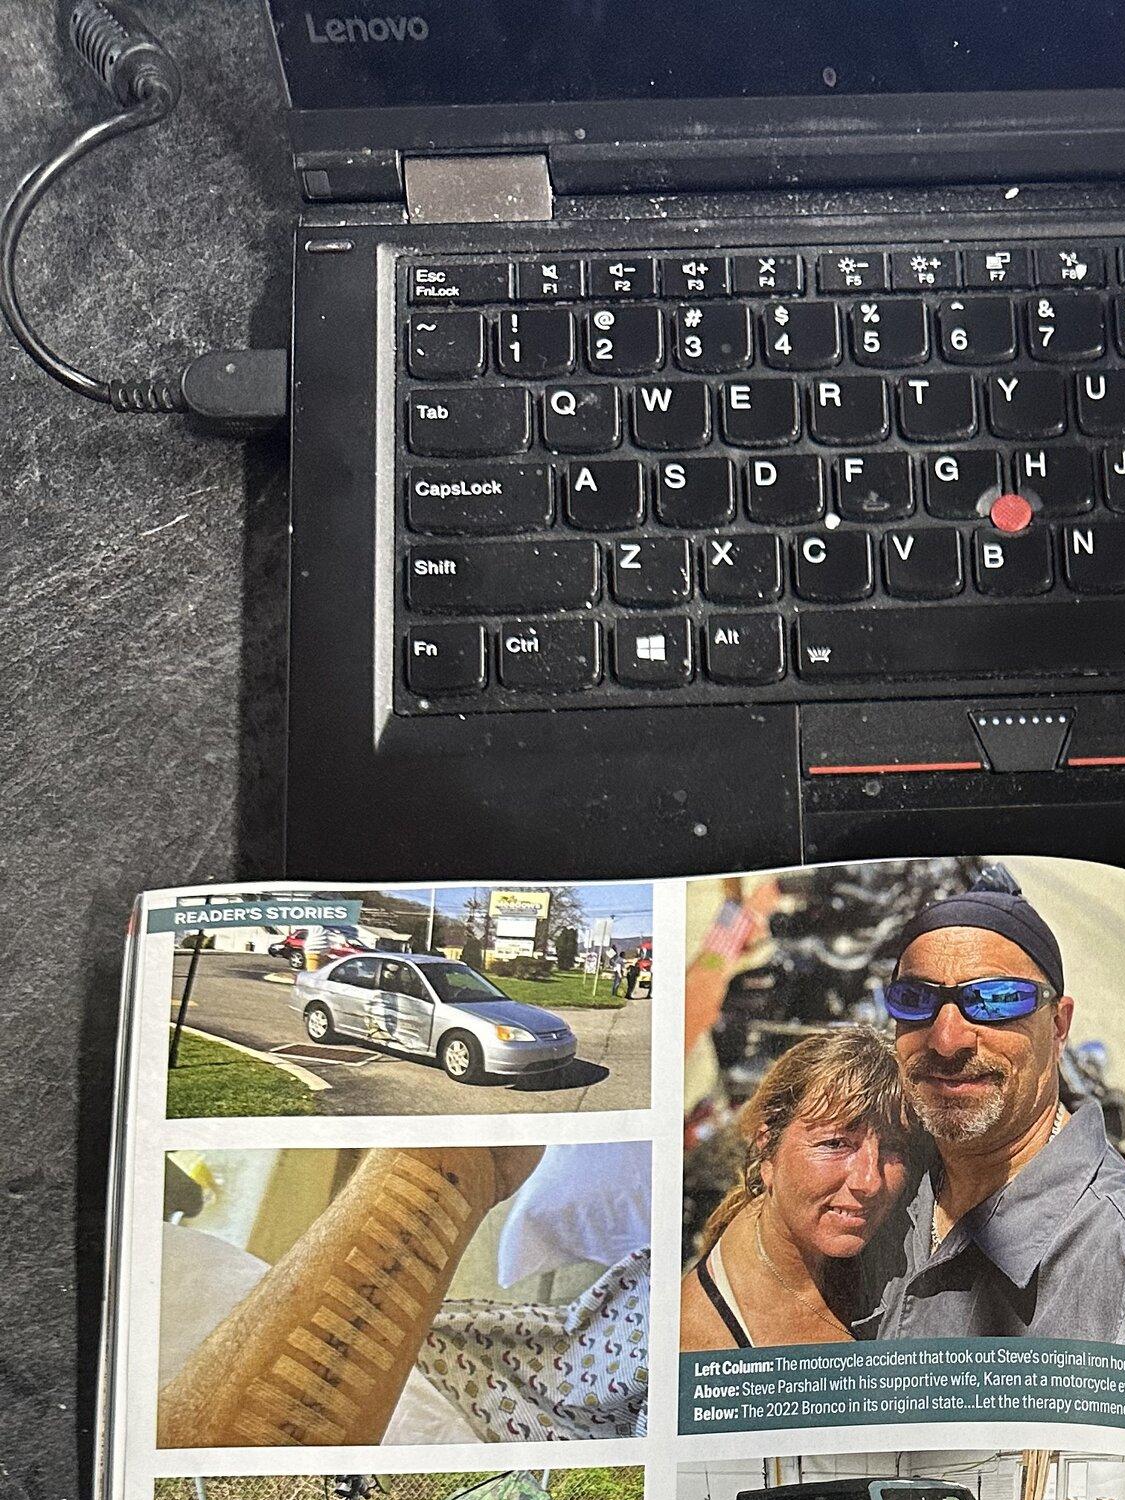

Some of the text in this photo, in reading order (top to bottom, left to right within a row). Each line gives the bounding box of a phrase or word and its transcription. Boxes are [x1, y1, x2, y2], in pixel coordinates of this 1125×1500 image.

[305, 13, 429, 43] Lenovo
[416, 268, 446, 283] Esc
[415, 285, 460, 297] FnLock
[416, 404, 449, 420] Tab
[415, 480, 503, 499] CapsLock
[414, 559, 457, 575] Shift
[505, 634, 539, 653] Ctrl
[714, 628, 740, 645] Alt
[413, 640, 438, 656] Fn
[174, 906, 348, 925] READER'S STORIES
[694, 1361, 721, 1377] Left
[721, 1359, 774, 1375] Column:
[774, 1356, 798, 1371] The
[798, 1352, 864, 1372] motorcycle
[864, 1350, 918, 1367] accident
[918, 1349, 944, 1365] that
[944, 1348, 973, 1364] took
[974, 1349, 996, 1363] out
[997, 1348, 1040, 1364] Steve's
[1040, 1349, 1086, 1368] original
[1087, 1351, 1109, 1368] iron
[693, 1383, 740, 1399] Above:
[741, 1381, 775, 1396] Steve
[777, 1376, 827, 1394] Parshall
[828, 1375, 856, 1391] with
[858, 1374, 877, 1389] his
[879, 1371, 948, 1391] supportive
[950, 1371, 980, 1388] wife,
[983, 1371, 1022, 1386] Karen
[1024, 1372, 1038, 1386] at
[1039, 1375, 1048, 1387] a
[1050, 1374, 1117, 1393] motorcycle
[693, 1405, 739, 1421] Below:
[740, 1403, 764, 1418] The
[765, 1400, 799, 1417] 2022
[801, 1400, 846, 1415] Bronco
[848, 1397, 860, 1412] in
[863, 1397, 878, 1412] its
[880, 1395, 929, 1414] original
[931, 1393, 996, 1409] state...Let
[997, 1393, 1020, 1409] the
[1021, 1393, 1072, 1414] therapy
